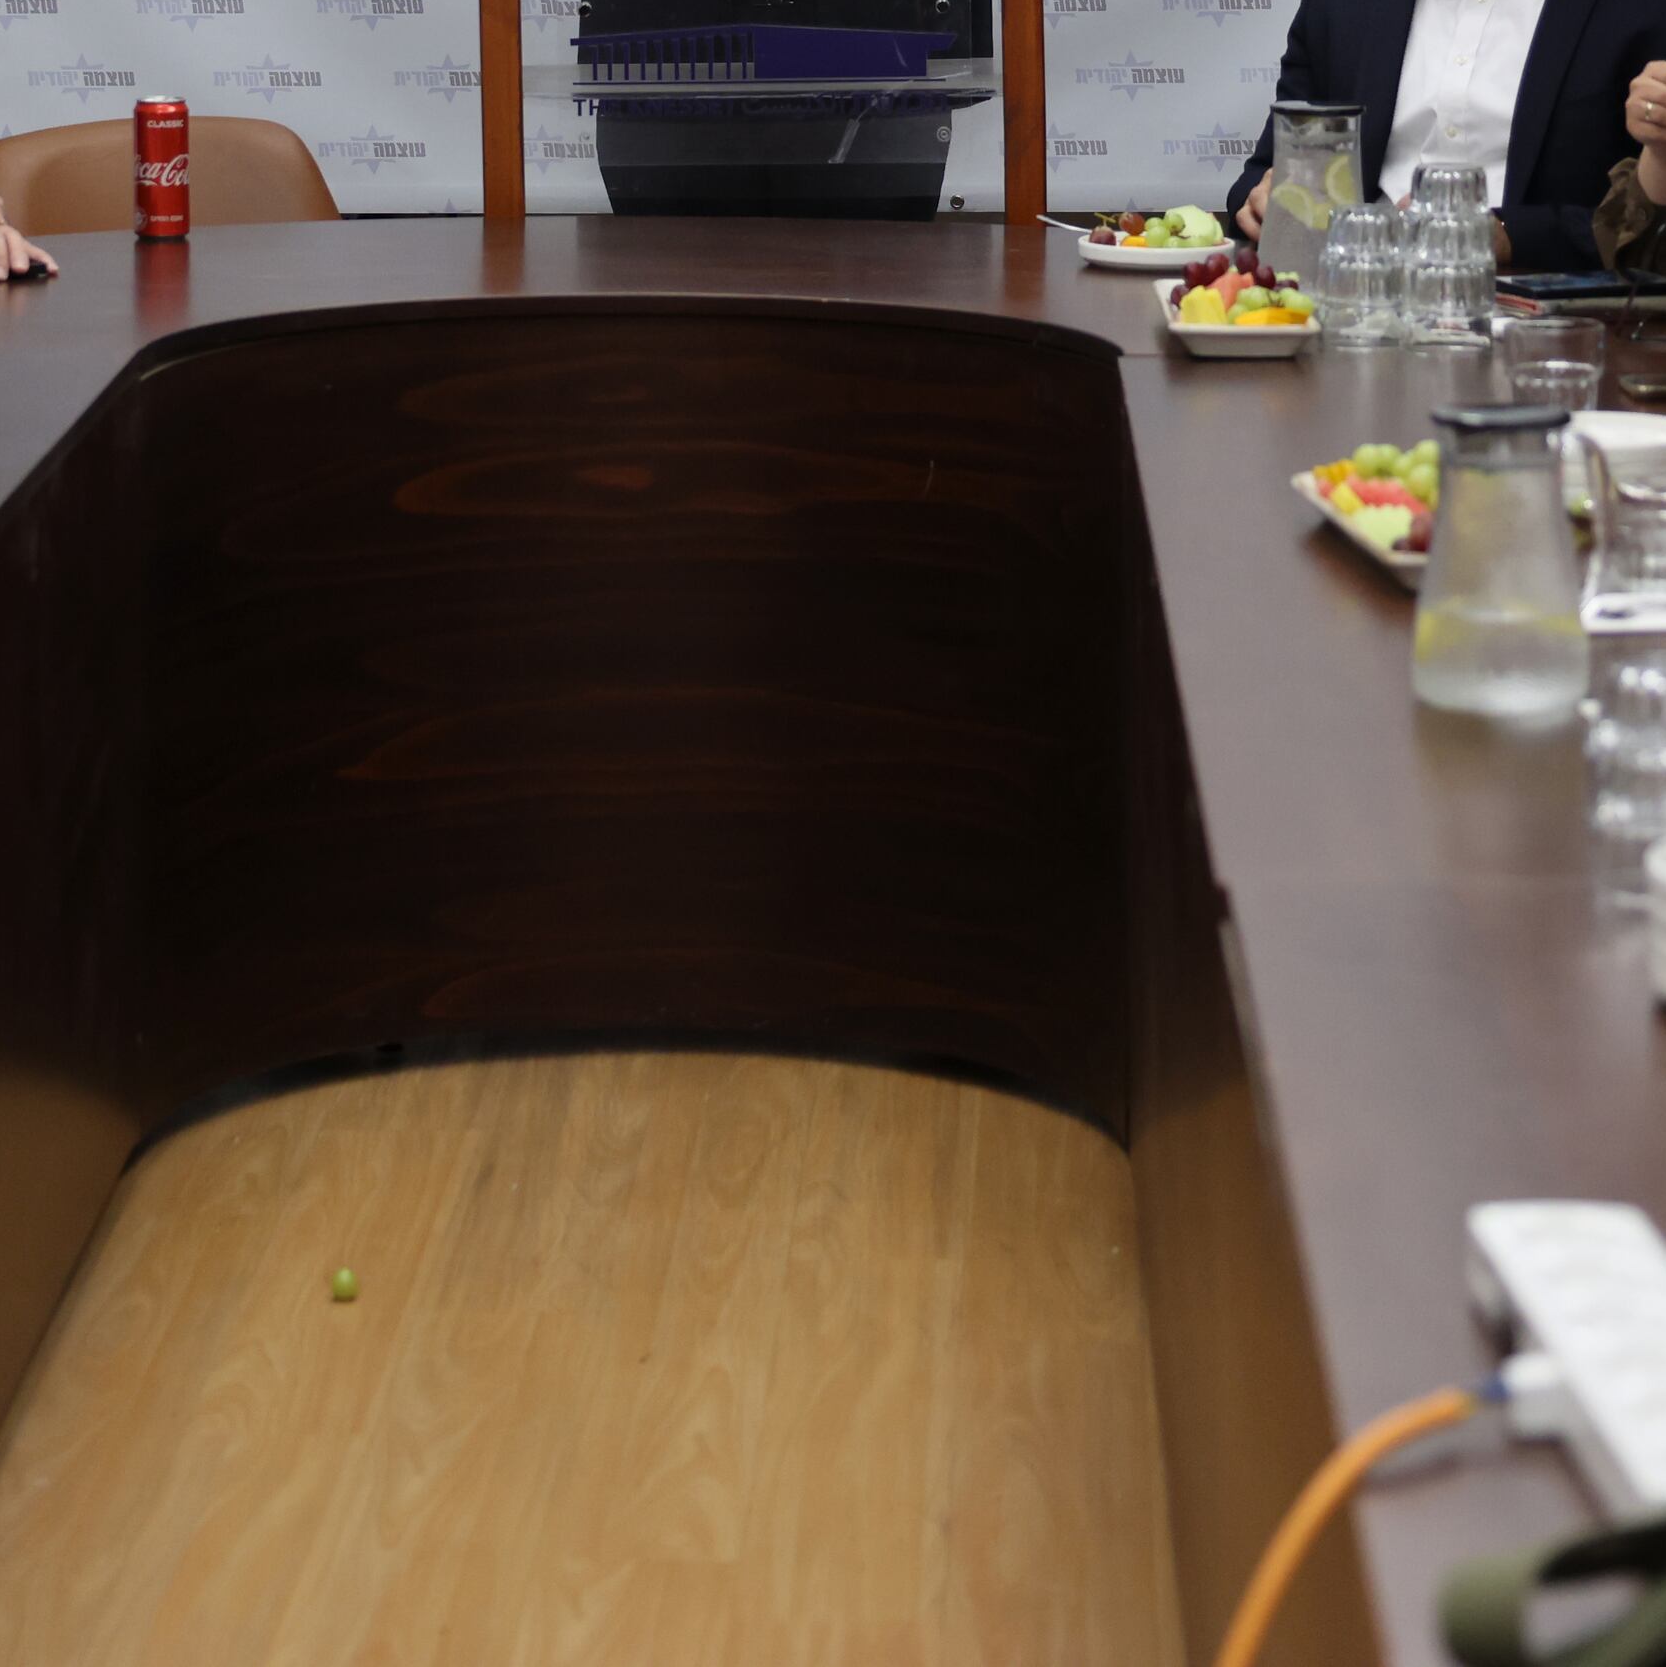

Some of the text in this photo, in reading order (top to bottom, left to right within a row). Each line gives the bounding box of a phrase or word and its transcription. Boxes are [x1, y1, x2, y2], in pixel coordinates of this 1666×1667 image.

[82, 71, 136, 87] עוצמה
[268, 71, 322, 87] עוצמה
[1131, 68, 1185, 84] עוצמה
[146, 119, 185, 129] CLASSIC
[373, 142, 426, 158] עוצמה
[1053, 140, 1108, 156] עוצמה
